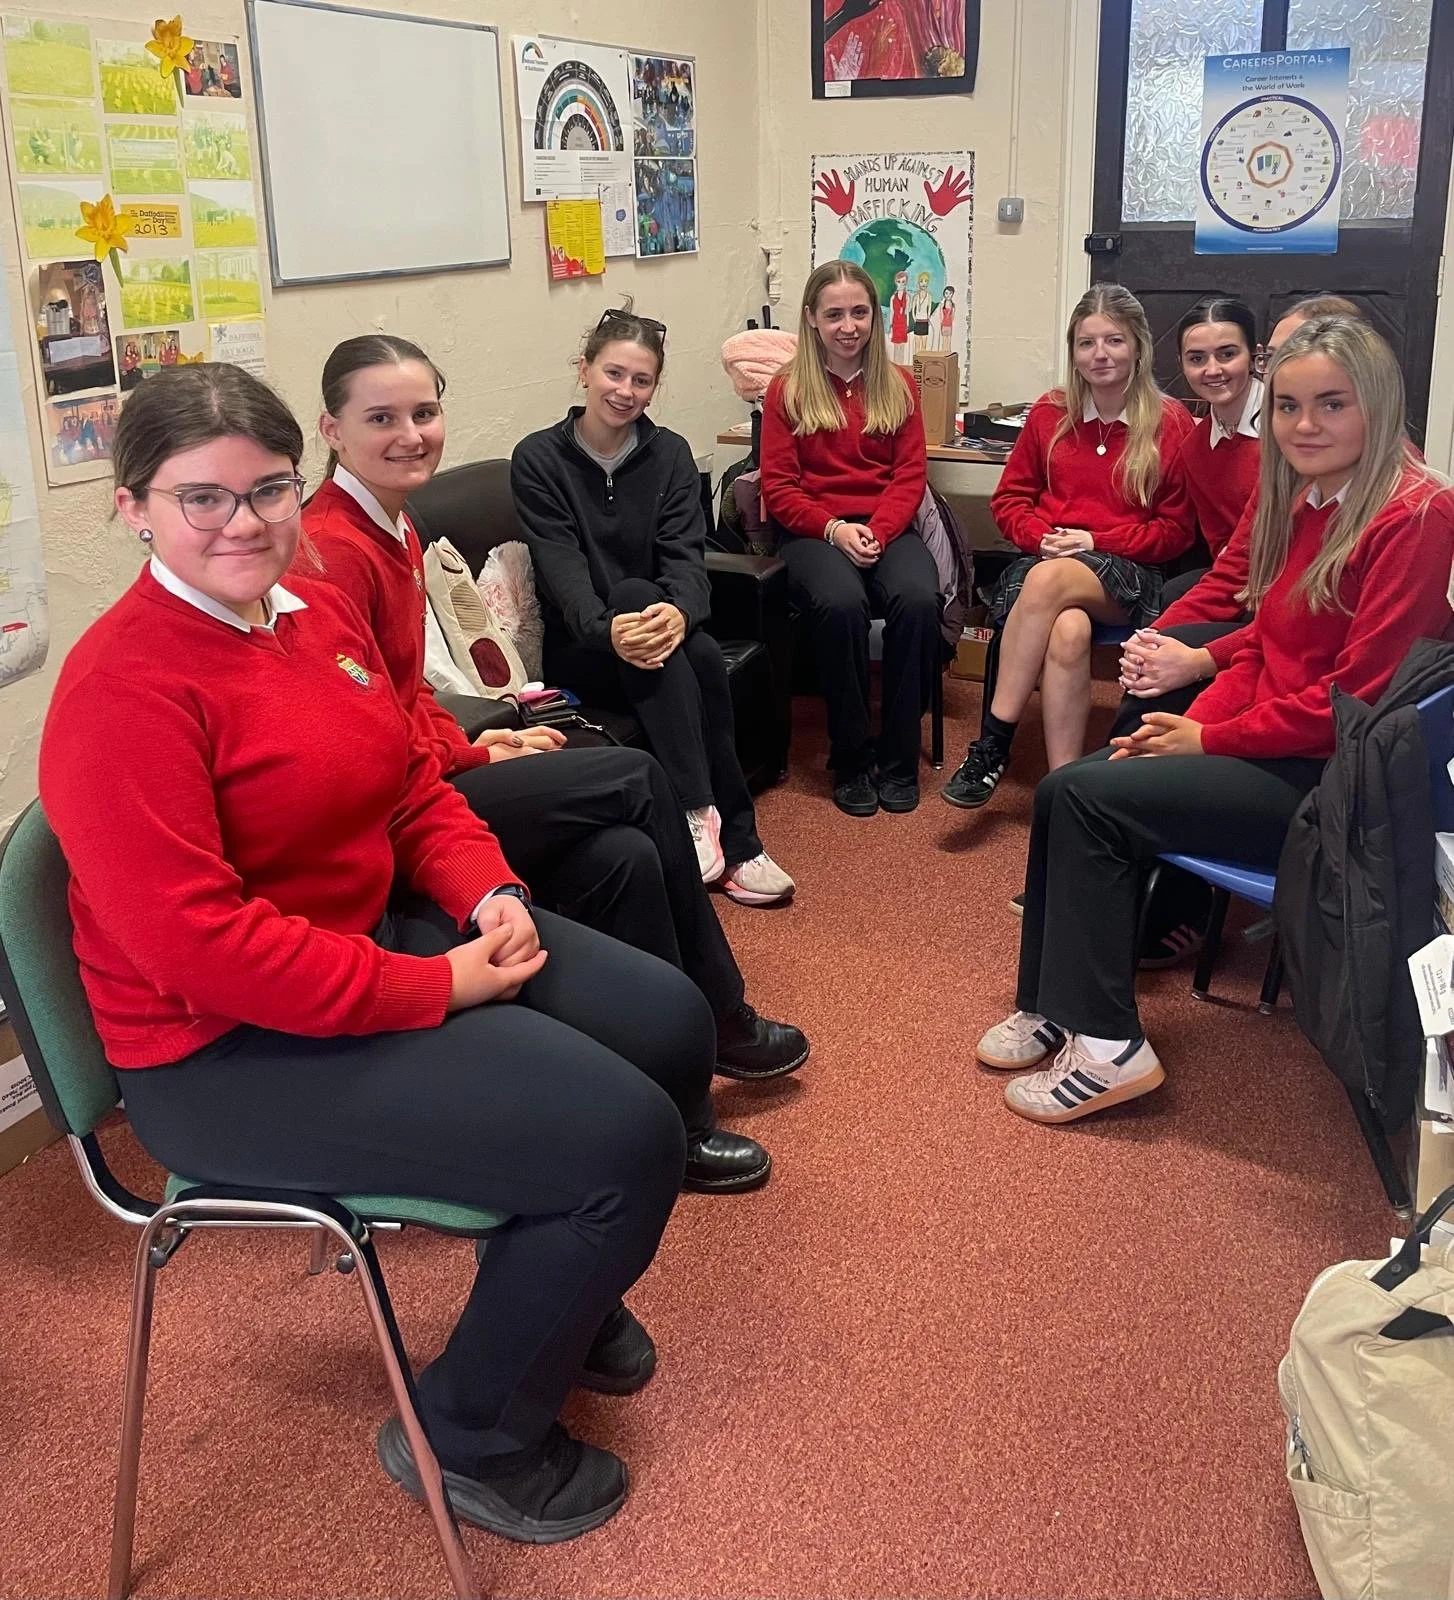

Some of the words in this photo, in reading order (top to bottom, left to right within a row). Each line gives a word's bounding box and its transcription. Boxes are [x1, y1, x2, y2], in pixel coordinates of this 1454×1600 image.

[1245, 75, 1268, 83] Career
[1269, 74, 1297, 82] Interests
[1255, 83, 1276, 91] World
[1277, 82, 1285, 90] of
[1286, 82, 1306, 90] Work
[884, 154, 898, 171] UP
[898, 156, 944, 185] AGAINST
[865, 177, 909, 193] HUMAN
[838, 198, 944, 233] TRAFFICKING
[134, 223, 169, 236] 2013
[914, 359, 924, 374] CUP
